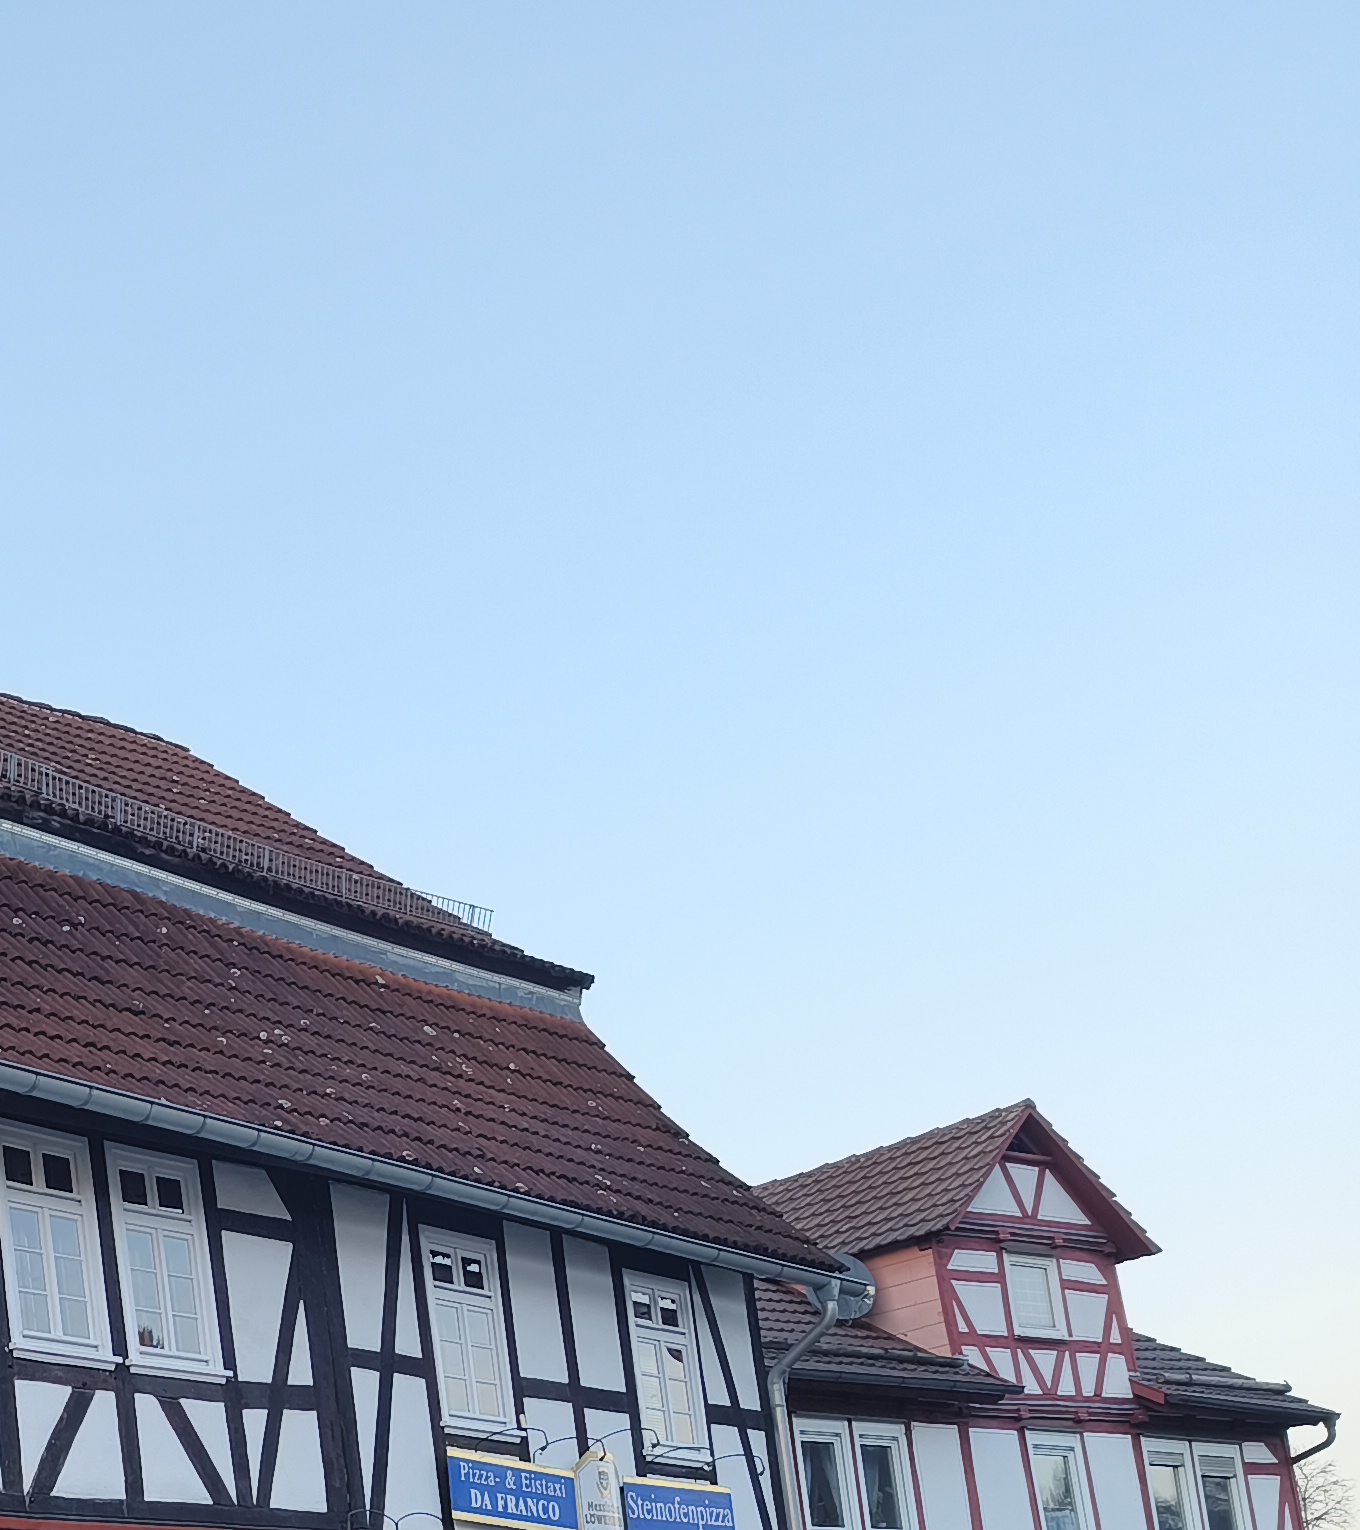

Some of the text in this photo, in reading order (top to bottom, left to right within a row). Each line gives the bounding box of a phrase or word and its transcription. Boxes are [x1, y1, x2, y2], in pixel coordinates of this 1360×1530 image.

[459, 1461, 566, 1498] Pizza- & Eistaxi
[469, 1488, 560, 1521] DA FRANCO
